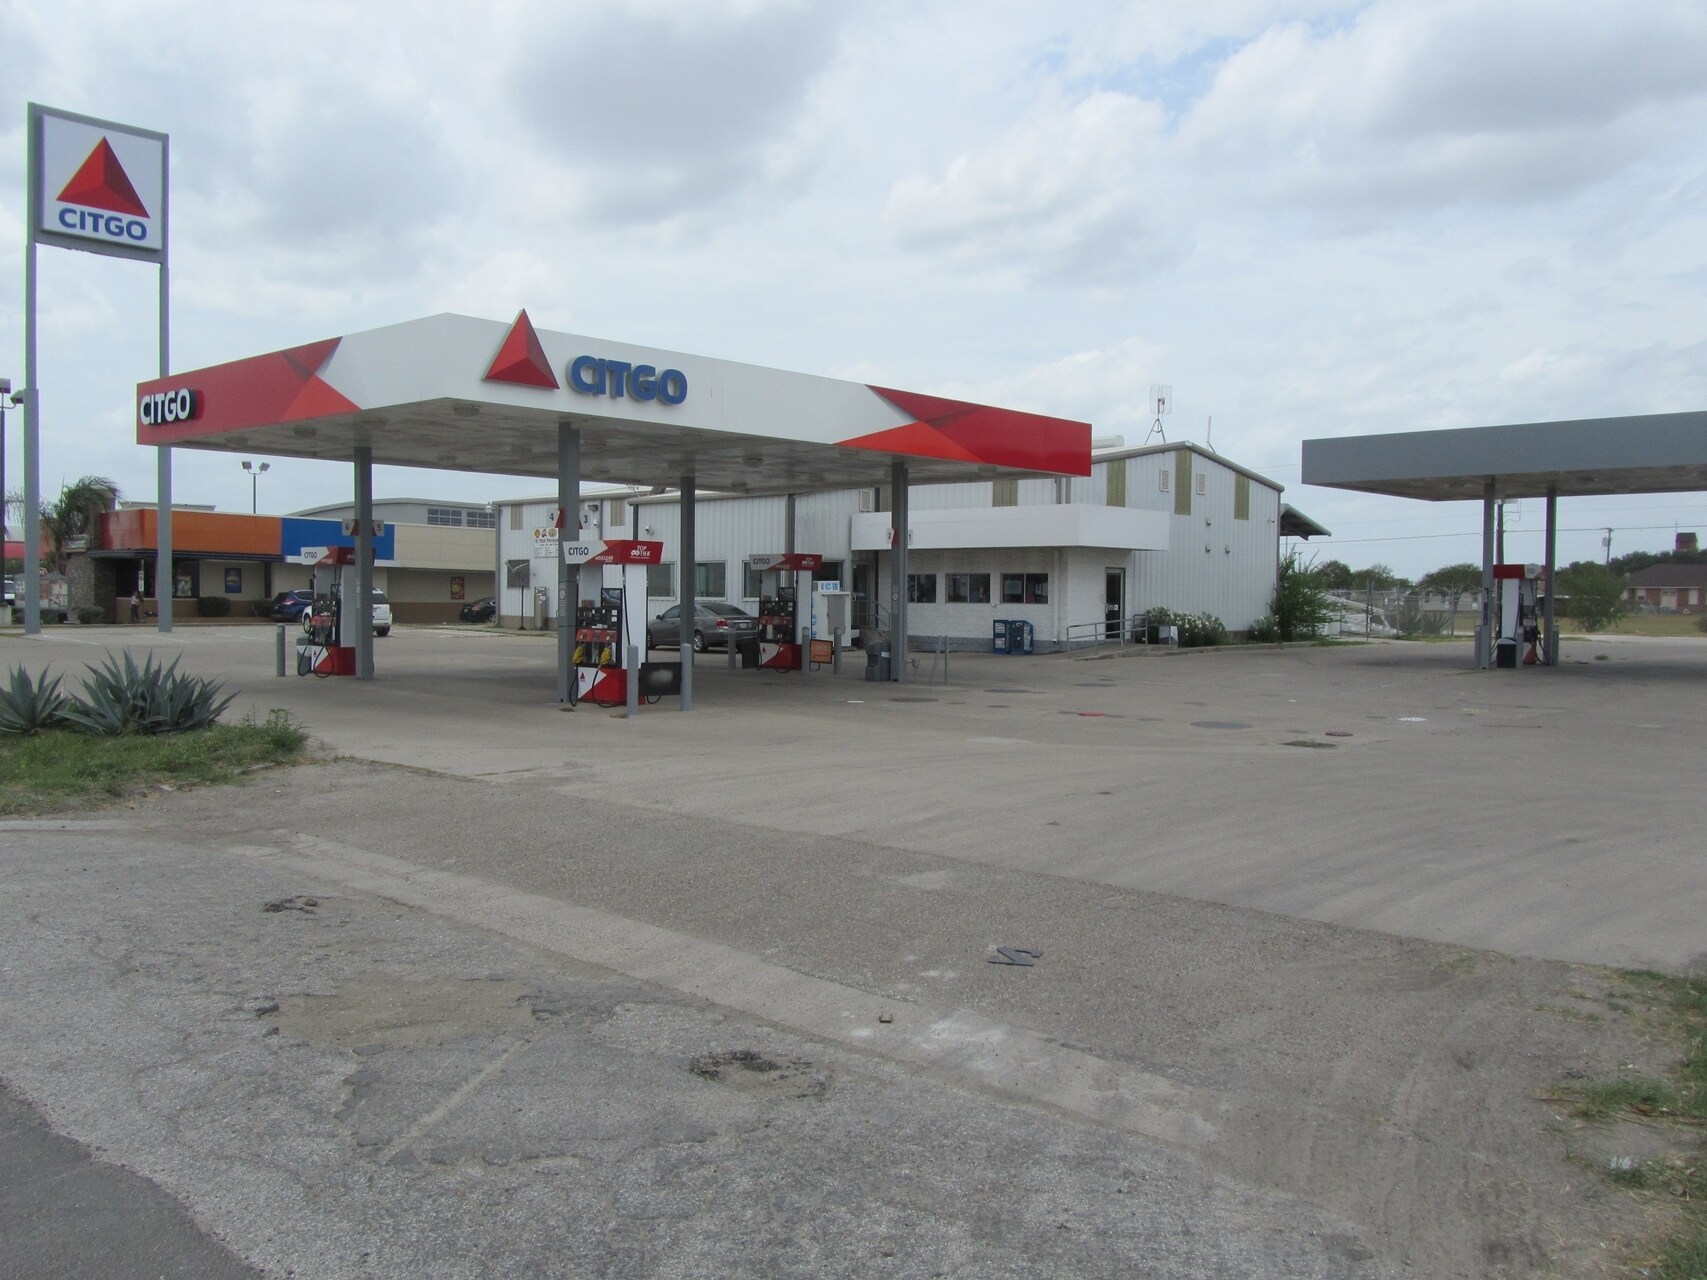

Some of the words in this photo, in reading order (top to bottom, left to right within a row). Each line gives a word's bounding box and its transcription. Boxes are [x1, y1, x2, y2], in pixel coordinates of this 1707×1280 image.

[59, 208, 147, 240] CITGO
[571, 355, 688, 404] CITGO
[140, 388, 190, 425] CITGO
[550, 512, 554, 521] 4
[584, 515, 588, 523] 3
[568, 547, 589, 556] CITGO
[753, 557, 770, 565] CITGO
[821, 582, 839, 591] ICE
